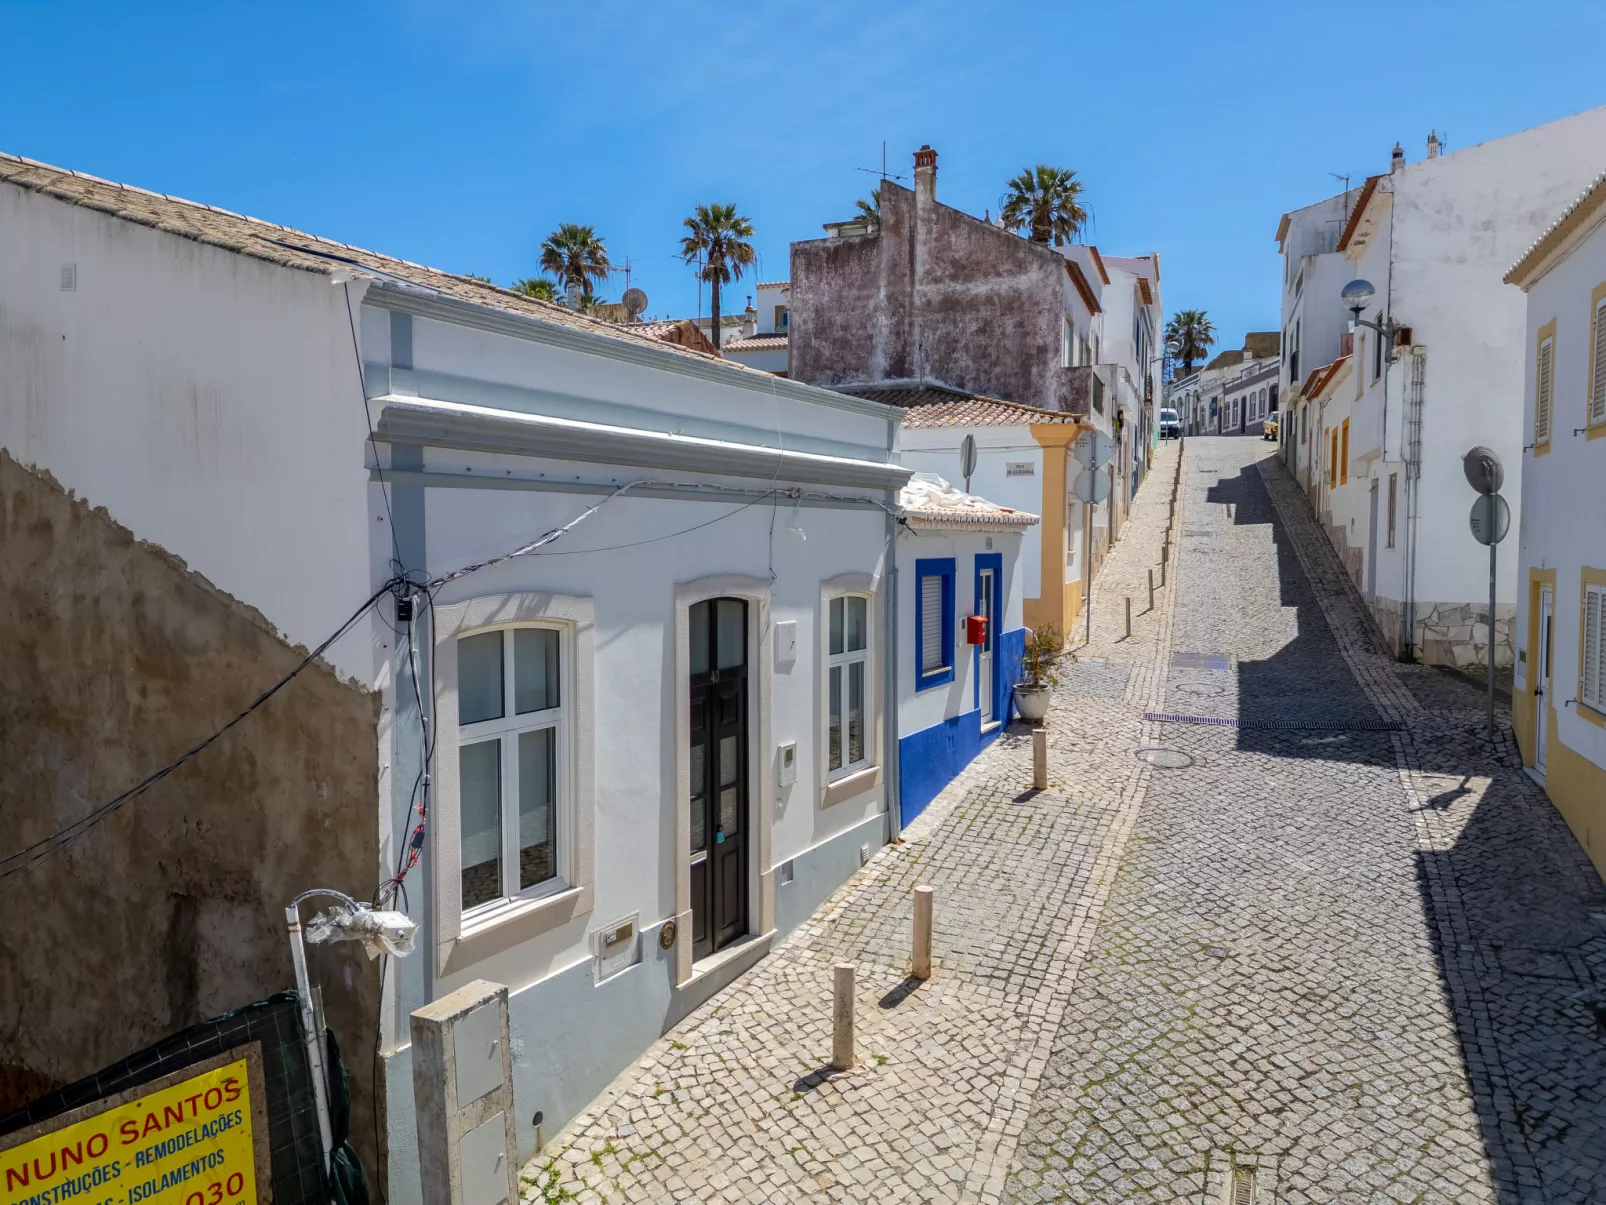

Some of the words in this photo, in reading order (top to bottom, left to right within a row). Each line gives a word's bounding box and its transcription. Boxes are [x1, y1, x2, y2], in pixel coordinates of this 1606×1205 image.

[6, 1133, 109, 1192] NUNO
[120, 1079, 241, 1145] SANTOS
[10, 1160, 121, 1205] NSTRUÇÕES
[135, 1109, 243, 1168] REMODELAÇÕES
[128, 1148, 225, 1205] ISOLAMENTOS
